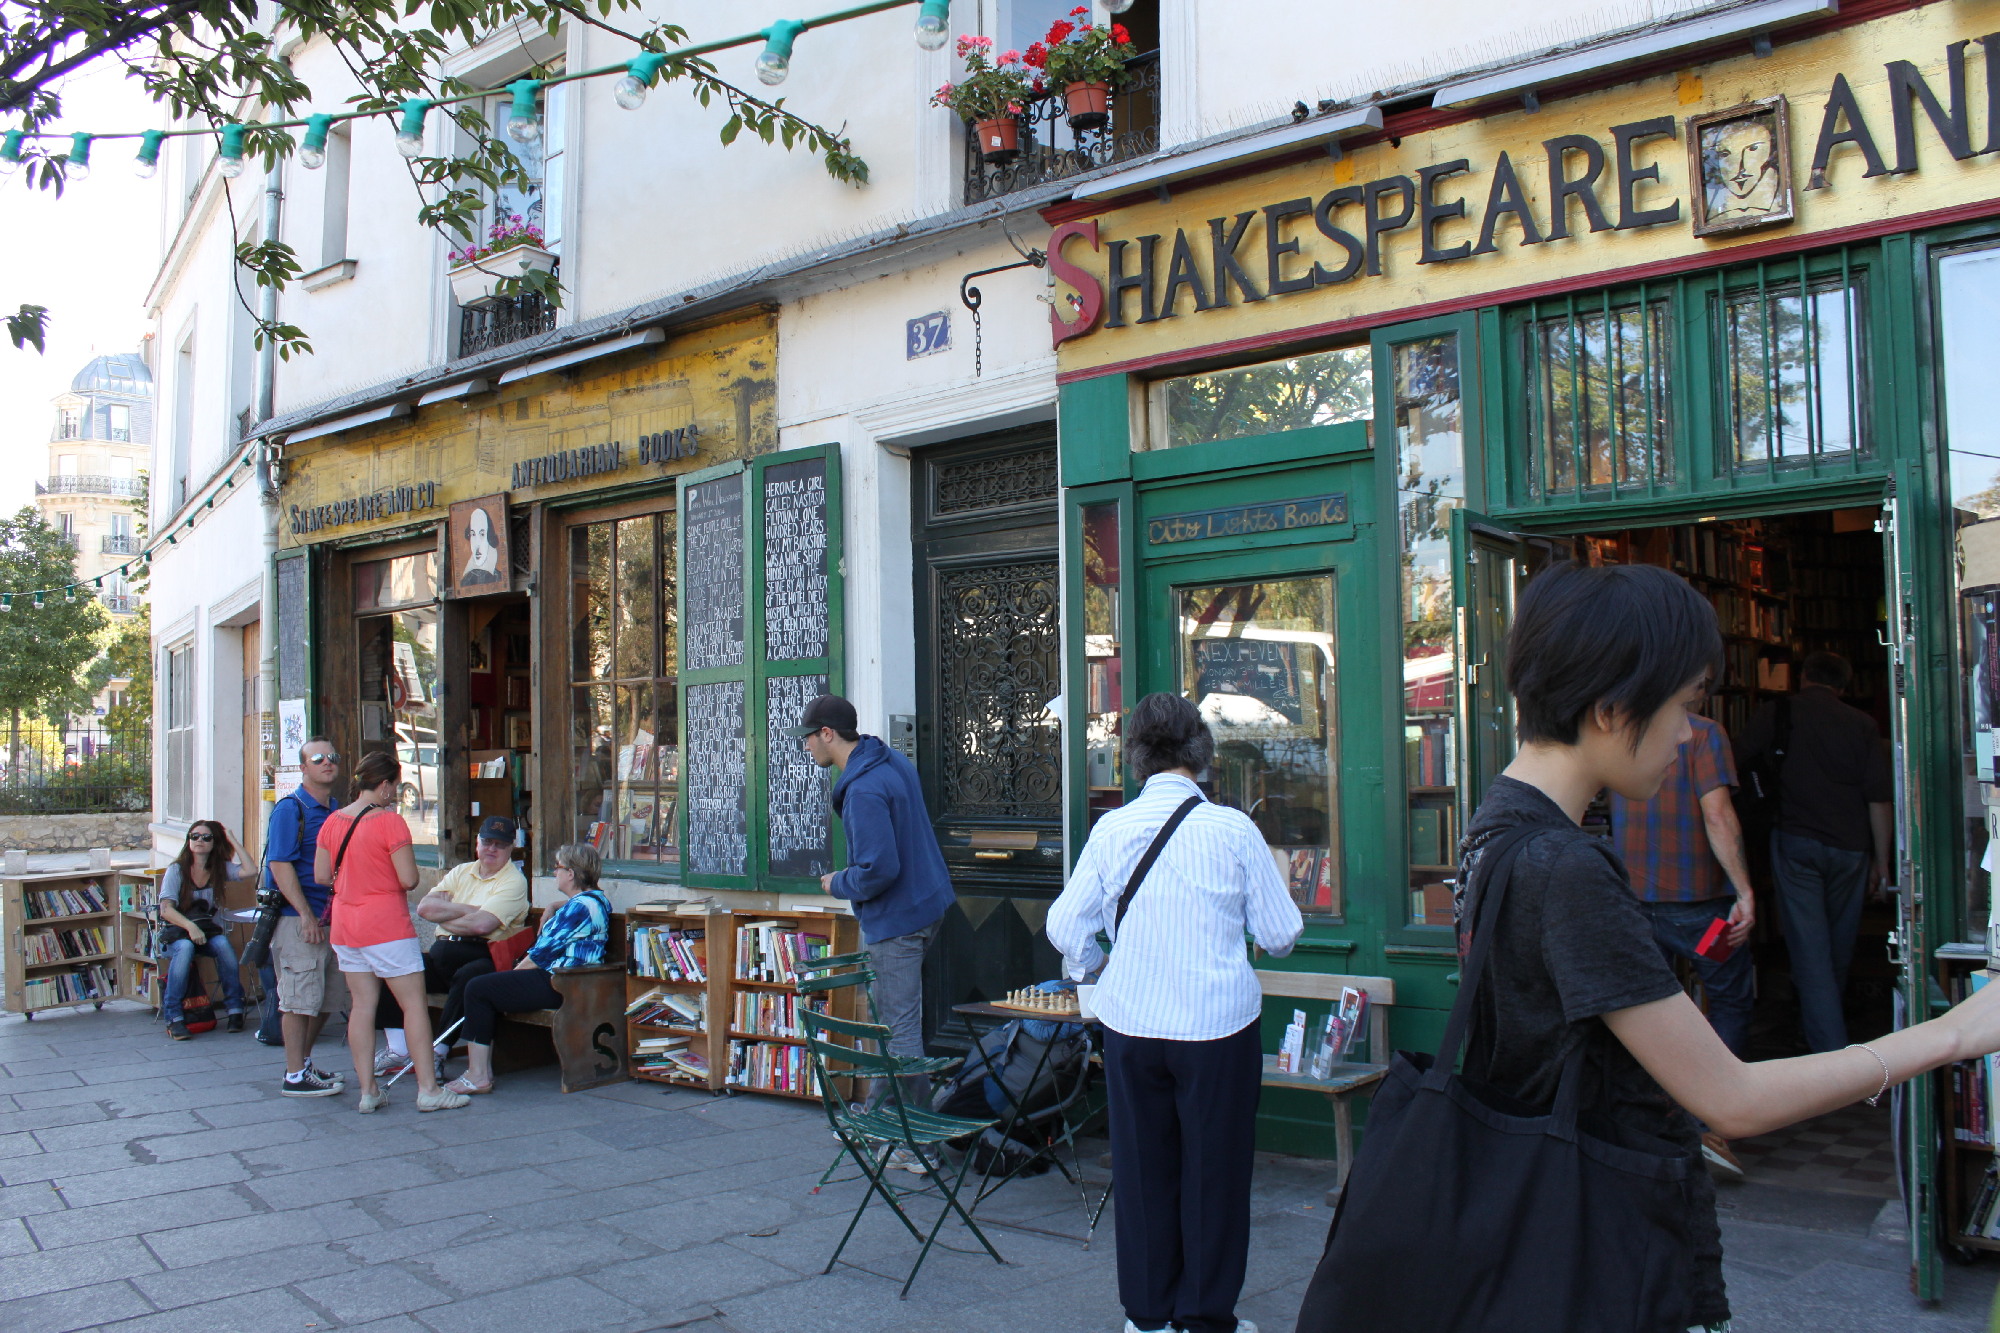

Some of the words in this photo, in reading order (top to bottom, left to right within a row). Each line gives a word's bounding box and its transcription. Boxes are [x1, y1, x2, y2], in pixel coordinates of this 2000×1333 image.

[1047, 116, 1681, 351] SHAKESPEARE
[912, 317, 944, 352] 37
[511, 441, 620, 490] ANTIQUARIAN
[639, 424, 698, 465] BOOKS
[290, 493, 382, 534] SHAKESPEARE
[387, 487, 413, 515] AND
[417, 481, 435, 508] CO
[766, 496, 791, 512] CALLED
[794, 490, 825, 509] NASTASIA
[803, 506, 819, 521] ONE
[687, 524, 702, 537] SOME
[704, 519, 719, 534] PEOPLE
[734, 515, 741, 527] ME
[766, 523, 798, 540] HUNDRED
[800, 520, 824, 535] YEARS
[1149, 517, 1201, 544] City
[1207, 509, 1277, 537] Lights
[782, 537, 792, 552] MY
[794, 534, 827, 550] BOOKSTORE
[766, 553, 778, 568] WAS
[779, 553, 784, 566] A
[785, 551, 801, 566] WINE
[803, 549, 822, 564] SHOP
[766, 567, 787, 581] HIDDEN
[789, 564, 804, 579] FROM
[806, 562, 819, 577] THE
[767, 580, 785, 594] SEINE
[787, 579, 794, 592] BY
[796, 577, 804, 591] AN
[807, 575, 828, 590] ANNEX
[766, 594, 773, 607] OF
[775, 592, 787, 607] THE
[788, 591, 807, 606] HOTEL
[766, 605, 790, 621] HOSPITAL
[793, 604, 812, 617] WHICH
[814, 603, 827, 616] HAS
[700, 620, 723, 636] INSTEAD
[725, 619, 732, 631] OF
[766, 619, 782, 632] SINCE
[784, 618, 798, 631] BEEN
[789, 628, 819, 645] REPLACED
[821, 629, 828, 642] BY
[767, 646, 772, 660] A
[806, 643, 823, 658] AND
[1202, 641, 1245, 662] NEXT
[687, 656, 699, 670] LIKE
[701, 655, 706, 668] A
[707, 652, 744, 667] FRUSTRATED
[768, 676, 799, 689] FURTHER
[800, 674, 817, 687] BACK
[820, 674, 826, 684] IN
[768, 686, 781, 698] THE
[784, 685, 800, 697] YEAR
[768, 697, 781, 709] OUR
[782, 694, 801, 709] WHOLE
[768, 708, 781, 720] WAS
[782, 708, 788, 720] A
[769, 718, 793, 730] CALLED
[769, 738, 798, 753] MEDIEVAL
[769, 751, 783, 765] EACH
[784, 750, 817, 765] MONASTE
[783, 766, 788, 778] A
[769, 778, 788, 792] WHOSE
[790, 778, 806, 791] DUTY
[808, 777, 821, 791] WAS
[787, 790, 799, 804] THE
[801, 791, 822, 804] LAMPS
[770, 826, 792, 838] YEARS
[819, 826, 827, 838] IS
